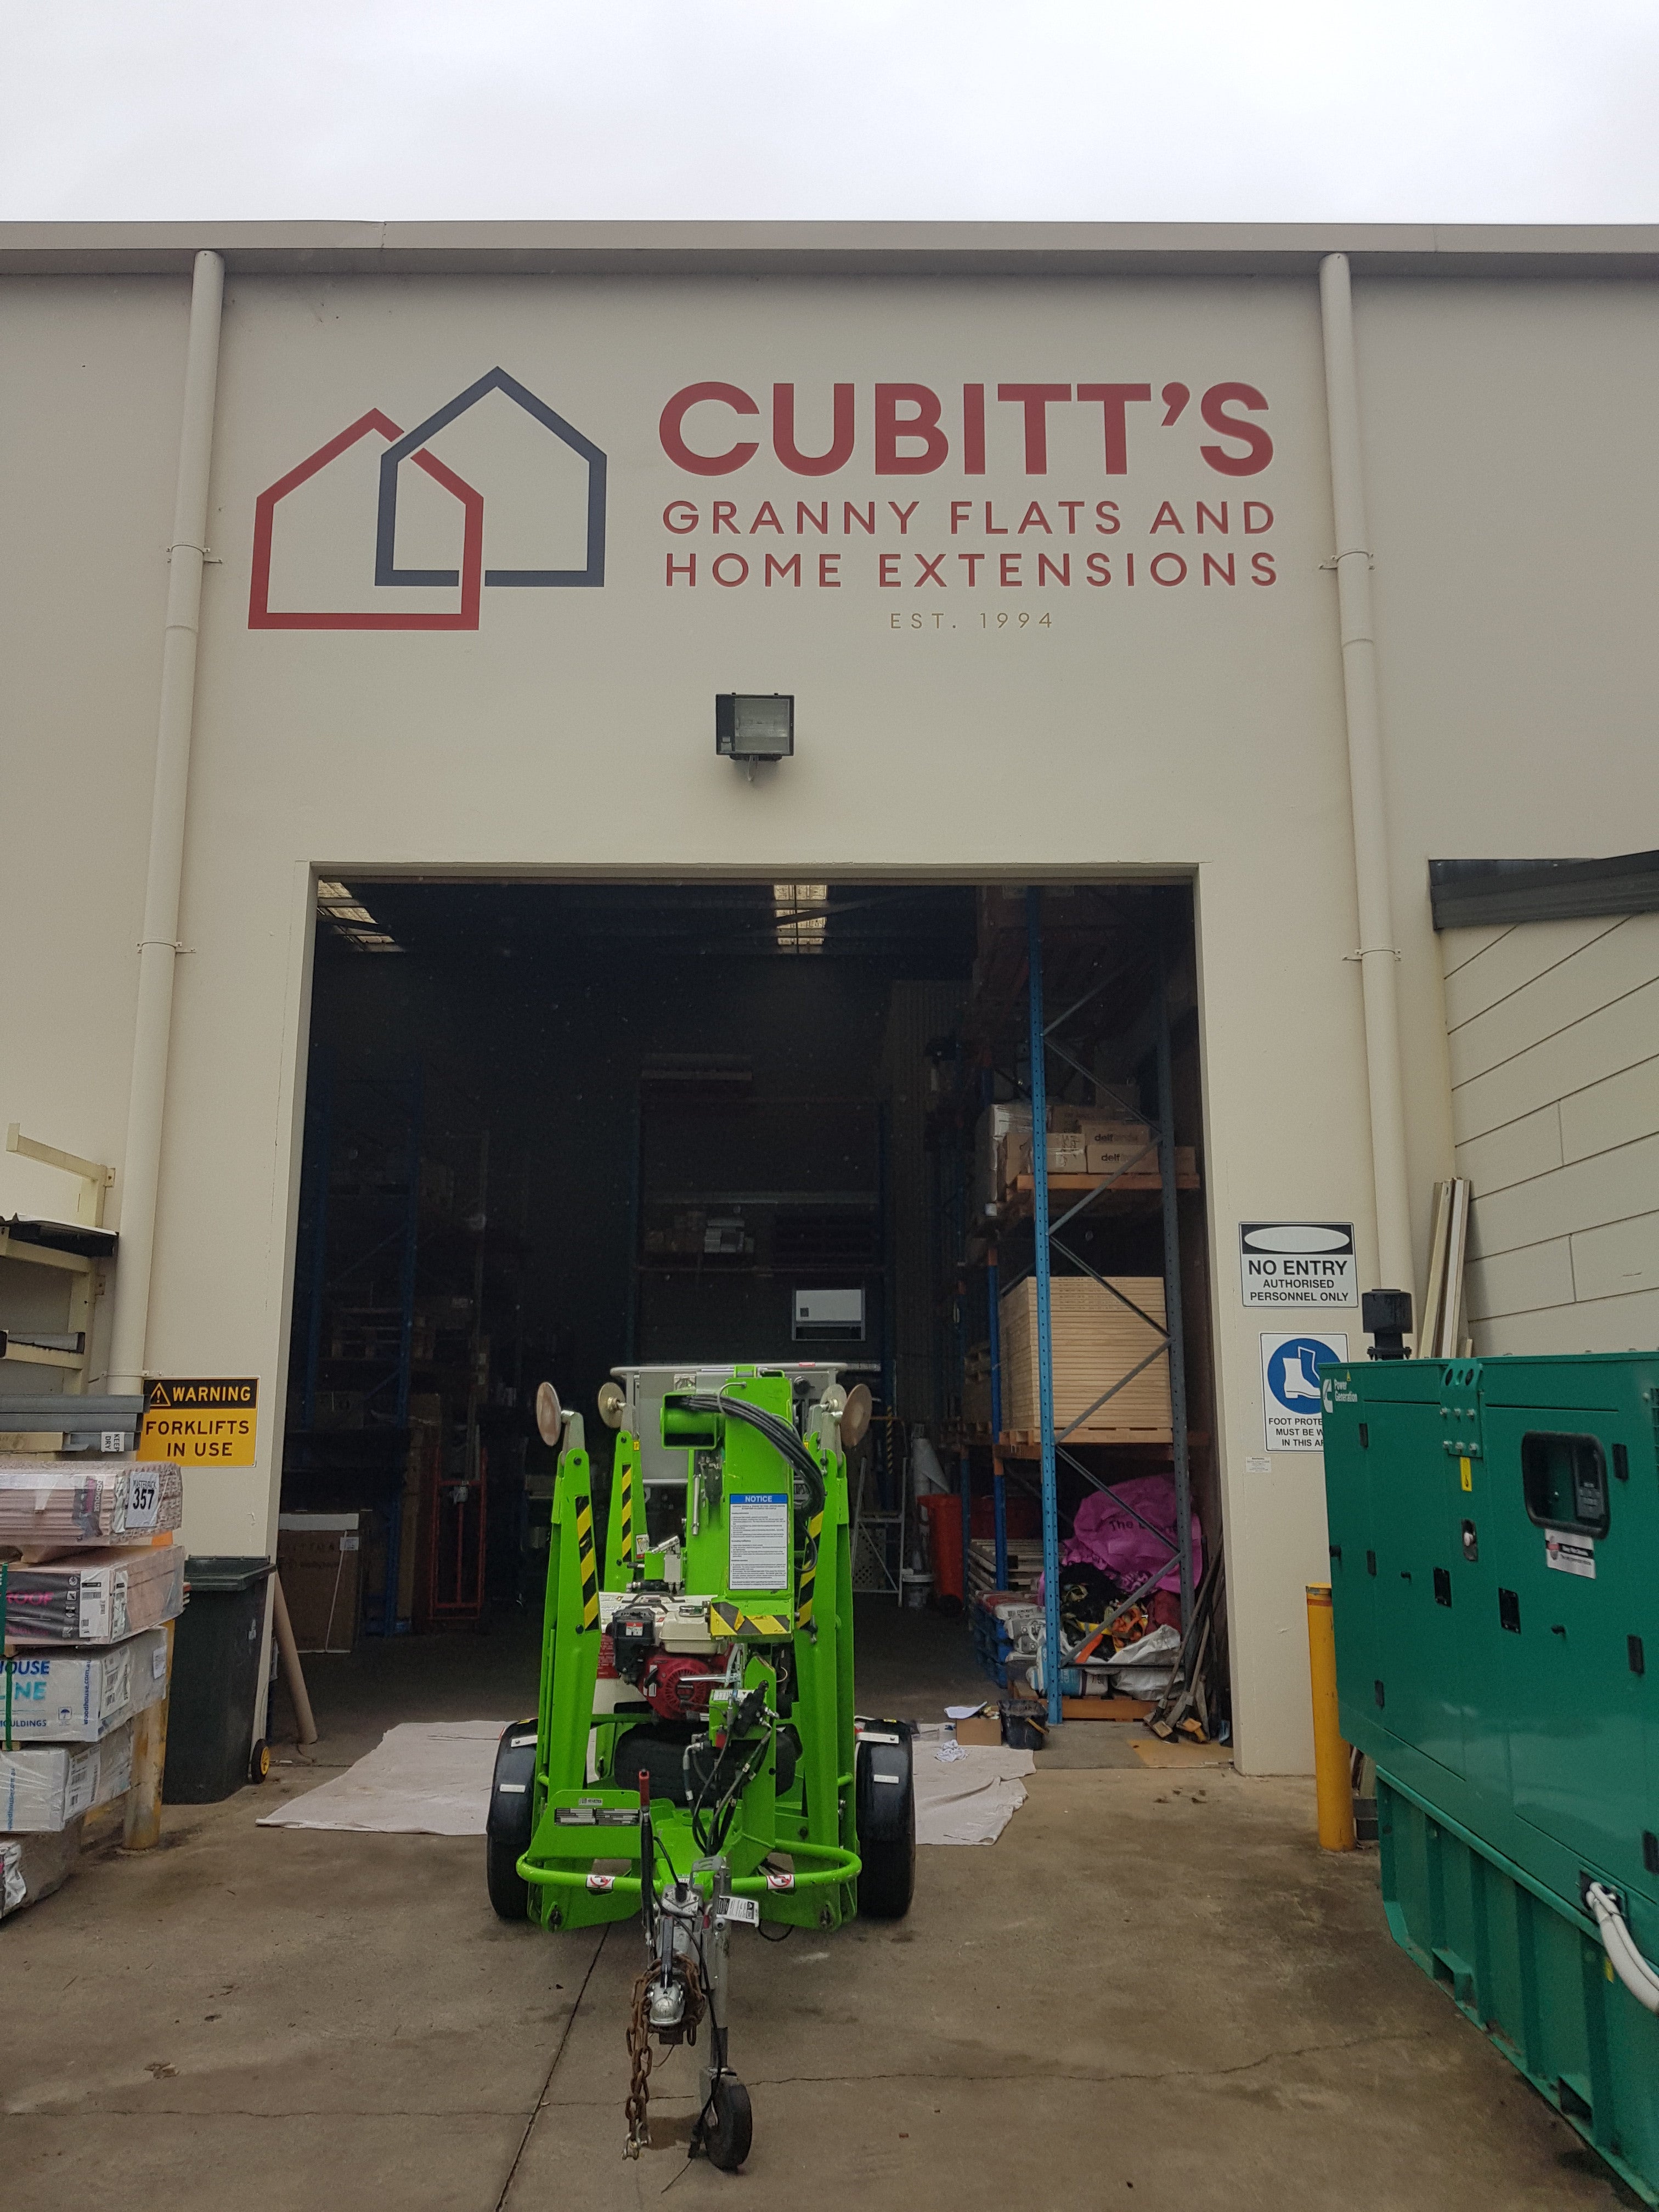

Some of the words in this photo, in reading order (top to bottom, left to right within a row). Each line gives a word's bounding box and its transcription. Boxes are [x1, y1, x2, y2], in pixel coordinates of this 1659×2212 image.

[659, 381, 1273, 476] CUBITT'S
[662, 500, 921, 535] GRANNY
[951, 501, 1121, 534] FLATS
[1149, 501, 1274, 534] AND
[666, 552, 842, 588] HOME
[879, 552, 1277, 588] EXTENSIONS
[890, 612, 957, 629] EST.
[979, 612, 1053, 629] 1994
[1249, 1260, 1277, 1276] NO
[1284, 1260, 1347, 1276] ENTRY
[1263, 1279, 1334, 1288] AUTHORISED
[1250, 1292, 1317, 1301] PERSONNEL
[1320, 1292, 1348, 1301] ONLY
[172, 1386, 251, 1402] WARNING
[145, 1420, 250, 1435] FORKLIFTS
[167, 1443, 185, 1457] IN
[194, 1442, 233, 1457] USE
[133, 1488, 155, 1510] 357
